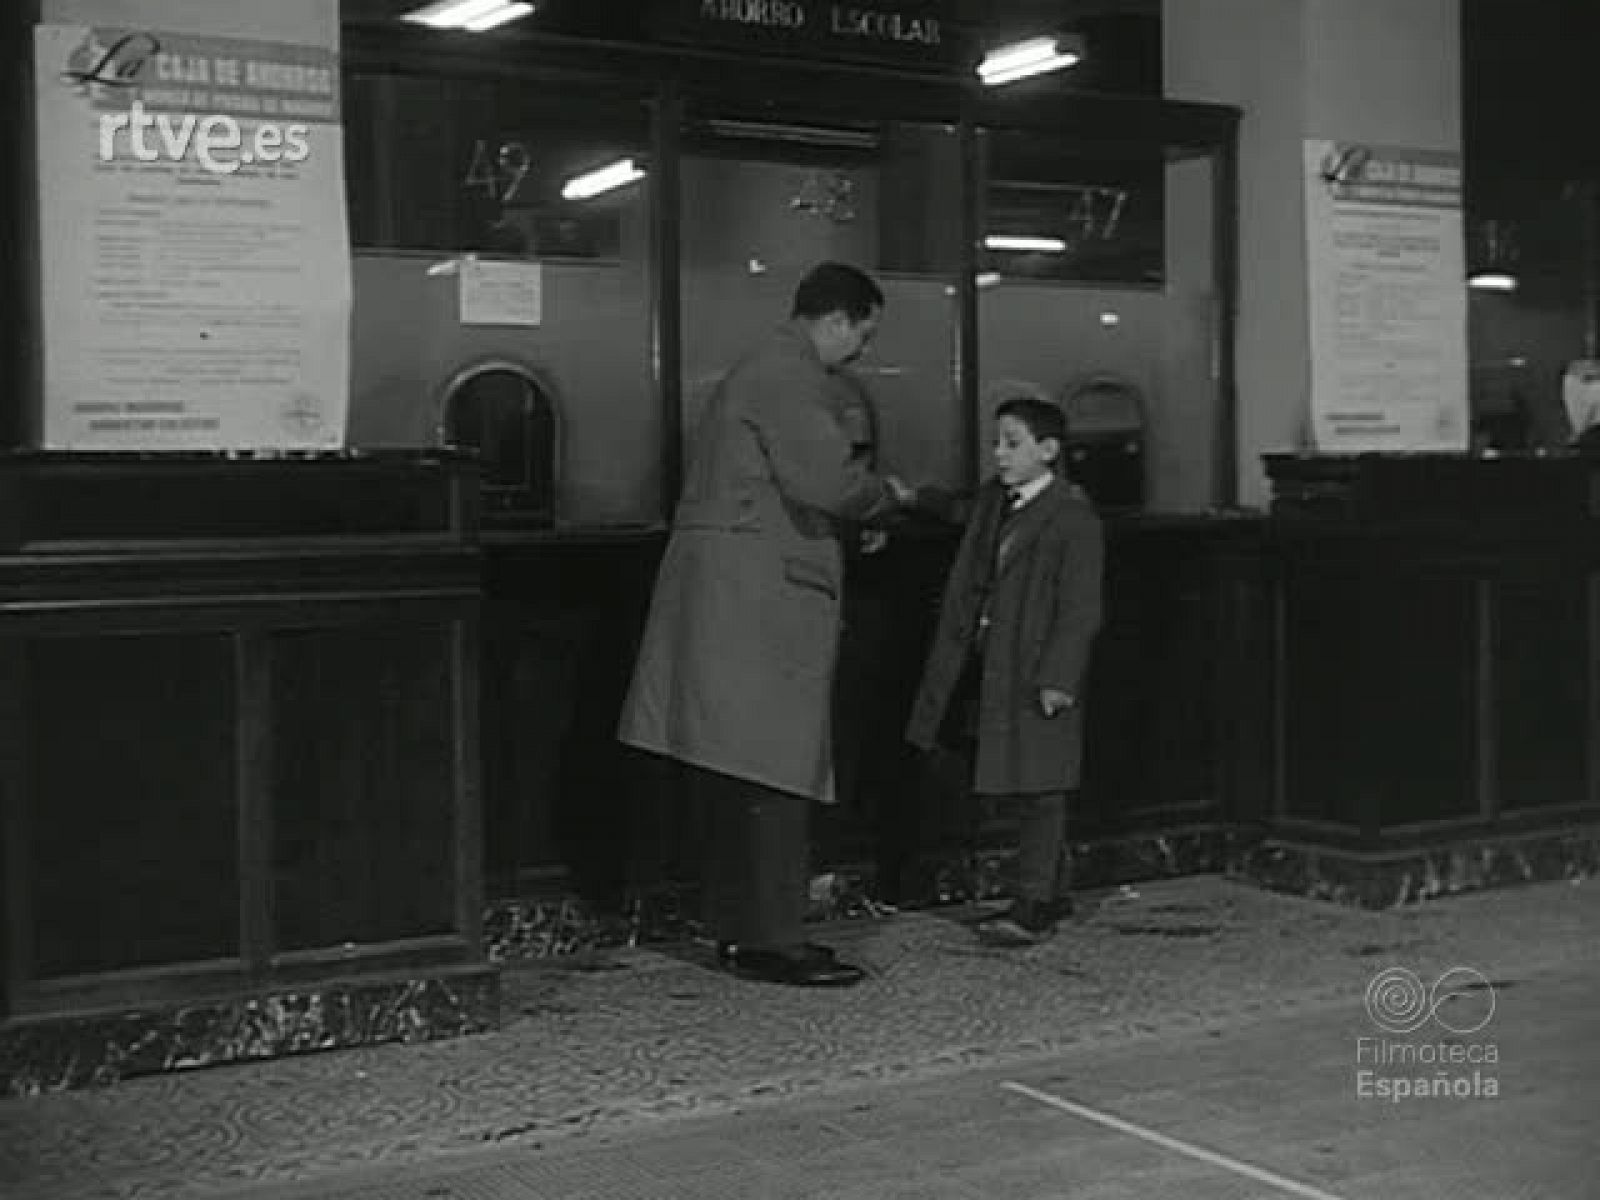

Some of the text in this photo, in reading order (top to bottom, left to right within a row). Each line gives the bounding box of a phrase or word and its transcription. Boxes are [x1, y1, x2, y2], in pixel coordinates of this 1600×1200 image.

[700, 0, 806, 27] AHORRO
[466, 140, 531, 201] 49
[1069, 187, 1128, 240] 47
